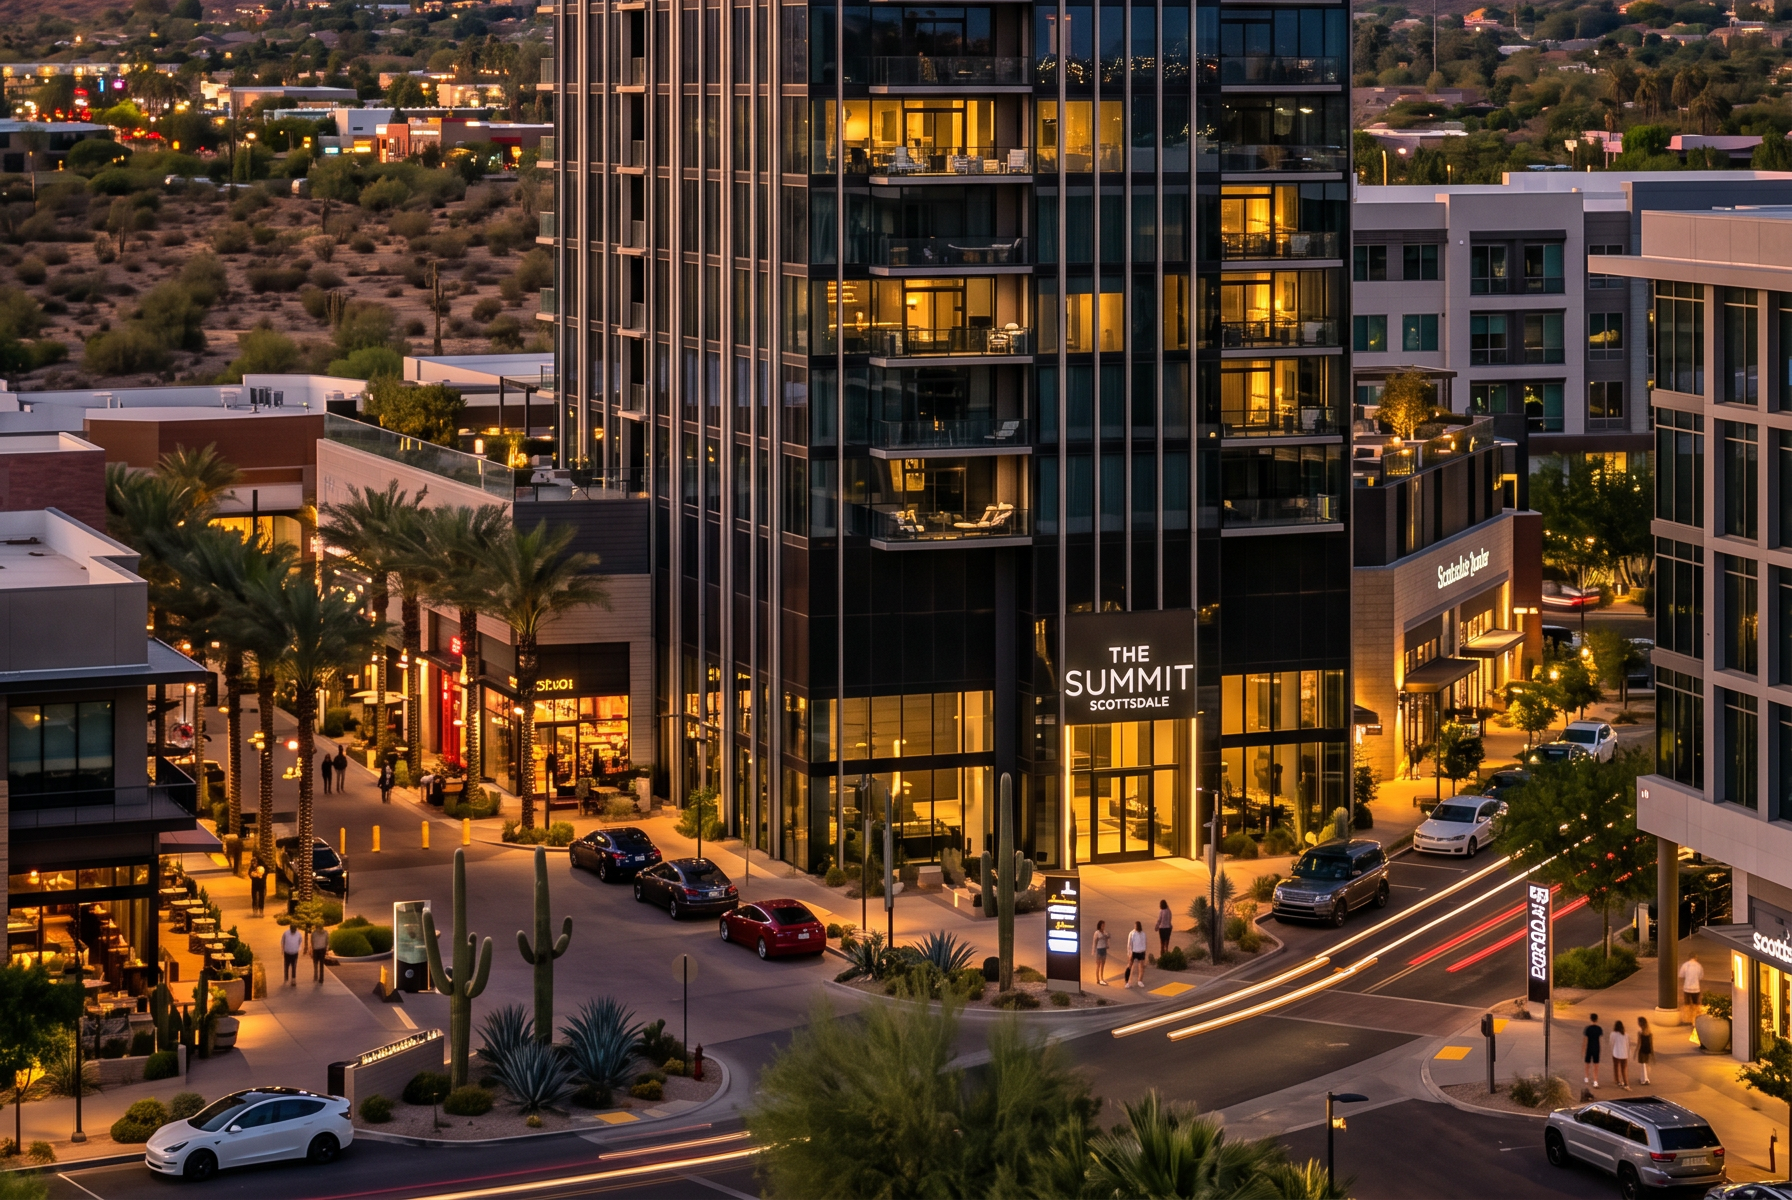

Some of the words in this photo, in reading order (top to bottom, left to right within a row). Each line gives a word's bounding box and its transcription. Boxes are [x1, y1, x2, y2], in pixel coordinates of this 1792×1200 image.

[1108, 645, 1150, 664] THE
[1065, 664, 1194, 697] SUMMIT
[1089, 696, 1170, 711] SCOTTSDALE
